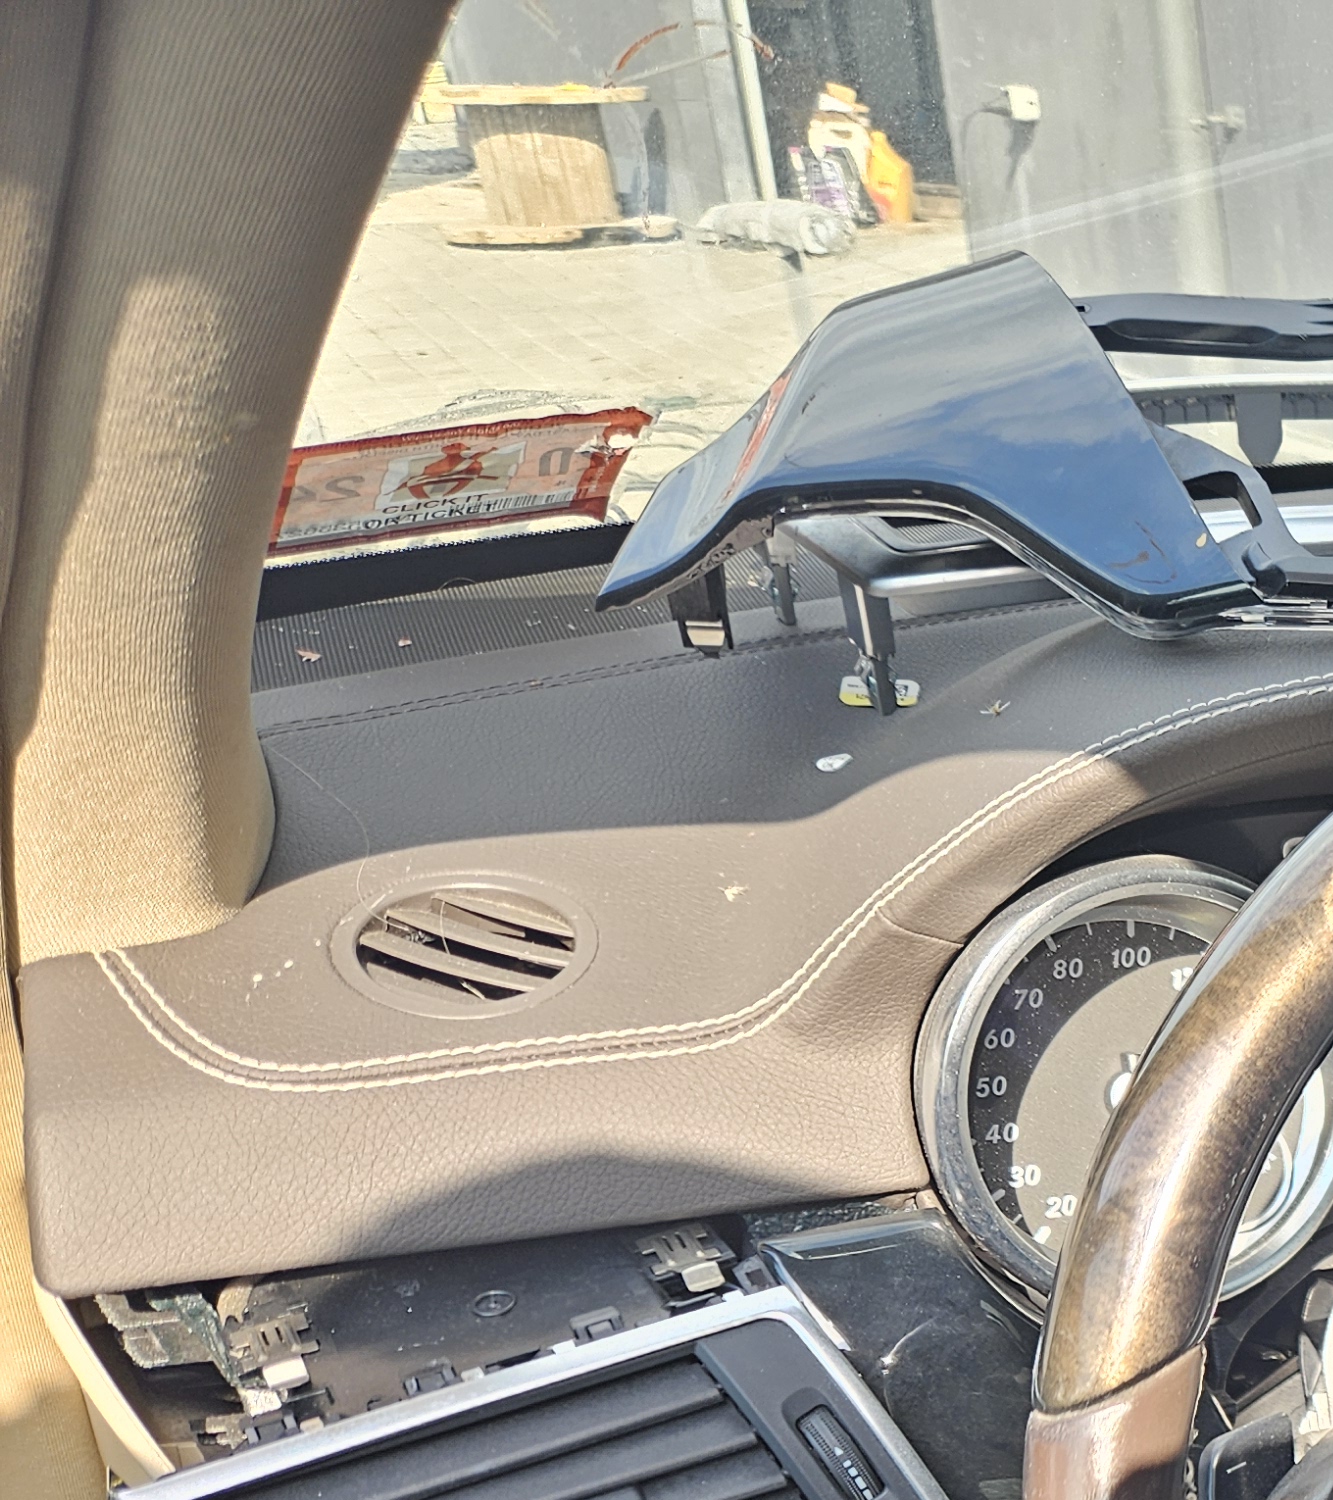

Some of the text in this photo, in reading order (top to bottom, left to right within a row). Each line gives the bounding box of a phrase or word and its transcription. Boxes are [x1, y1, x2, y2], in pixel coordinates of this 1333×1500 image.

[381, 493, 489, 515] CLICK IT
[402, 502, 499, 524] TICKET
[1052, 957, 1084, 981] 80
[1111, 946, 1152, 969] 100
[1013, 987, 1044, 1011] 70
[983, 1027, 1016, 1051] 60
[974, 1075, 1008, 1099] 50
[985, 1121, 1020, 1145] 40
[1008, 1163, 1042, 1189] 30
[1044, 1193, 1078, 1220] 20
